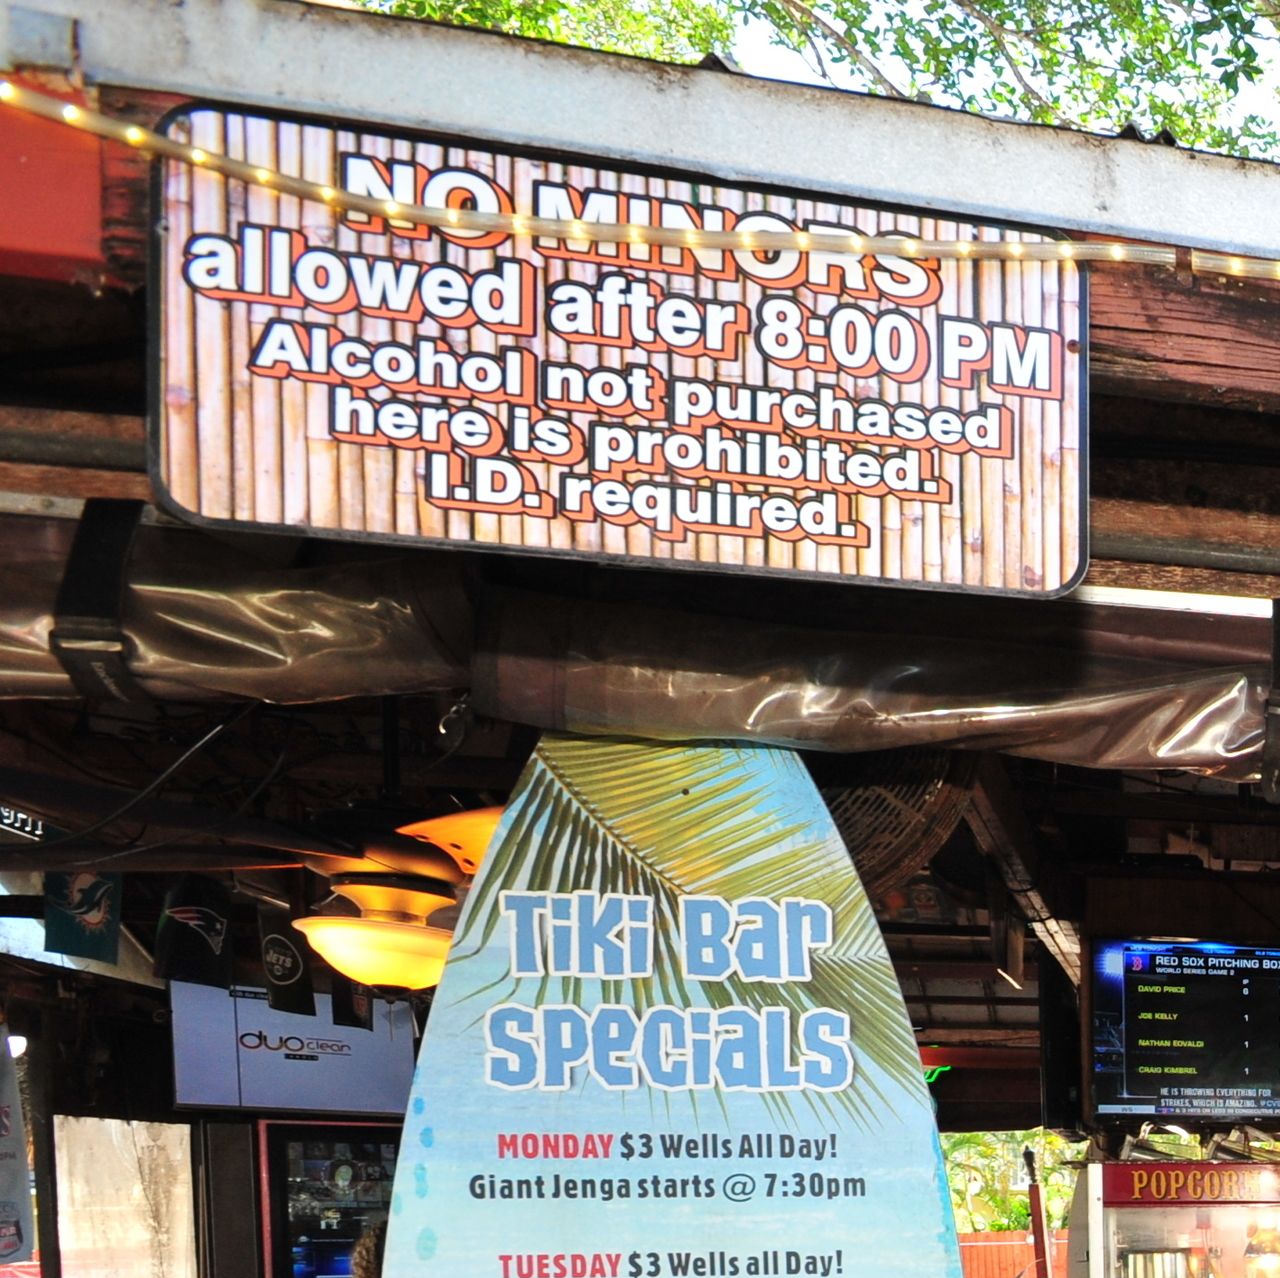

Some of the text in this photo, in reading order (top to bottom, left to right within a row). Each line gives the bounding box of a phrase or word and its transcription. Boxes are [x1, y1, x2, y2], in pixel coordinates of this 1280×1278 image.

[341, 154, 941, 303] NO MINORS
[185, 225, 1063, 398] allowed after 8:00 PM
[251, 319, 1012, 458] Alcohol not purchased
[331, 385, 951, 503] here is prohibited.
[428, 451, 870, 548] I.D. required.
[1156, 956, 1178, 966] RED
[1182, 957, 1204, 967] SOX
[1208, 958, 1259, 969] PITCHING
[497, 1133, 838, 1161] MONDAY $3 Wells All Day!
[469, 1173, 866, 1203] Giant Jenga starts @ 7:30pm
[1132, 1170, 1261, 1199] POPCORN
[499, 1250, 843, 1278] TUESDAY $3 Wells all Day!
